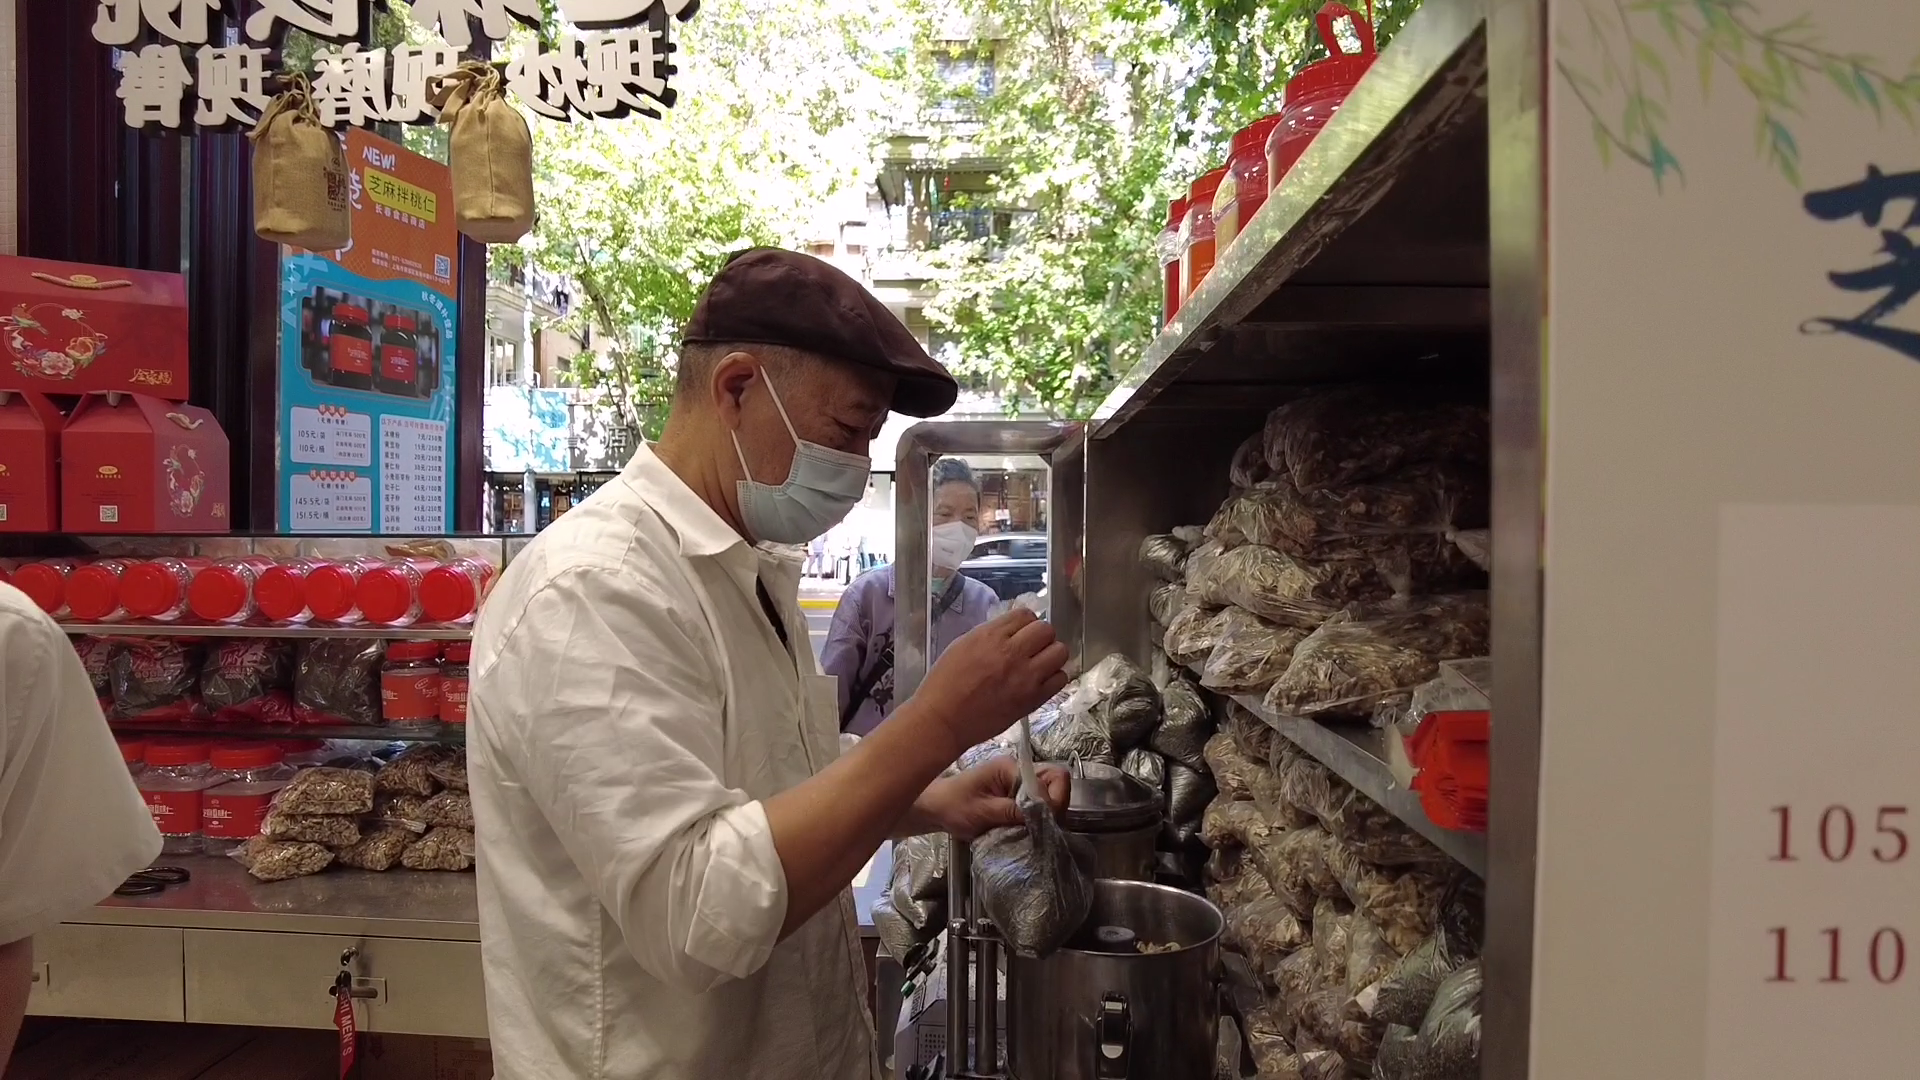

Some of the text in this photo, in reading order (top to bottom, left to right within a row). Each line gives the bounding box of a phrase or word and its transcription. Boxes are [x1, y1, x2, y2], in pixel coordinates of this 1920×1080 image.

[362, 146, 396, 171] NEW!
[368, 174, 435, 214] 芝麻拌桃仁
[375, 204, 426, 229] 长春食品商店
[1767, 804, 1909, 863] 105
[1763, 926, 1906, 985] 110
